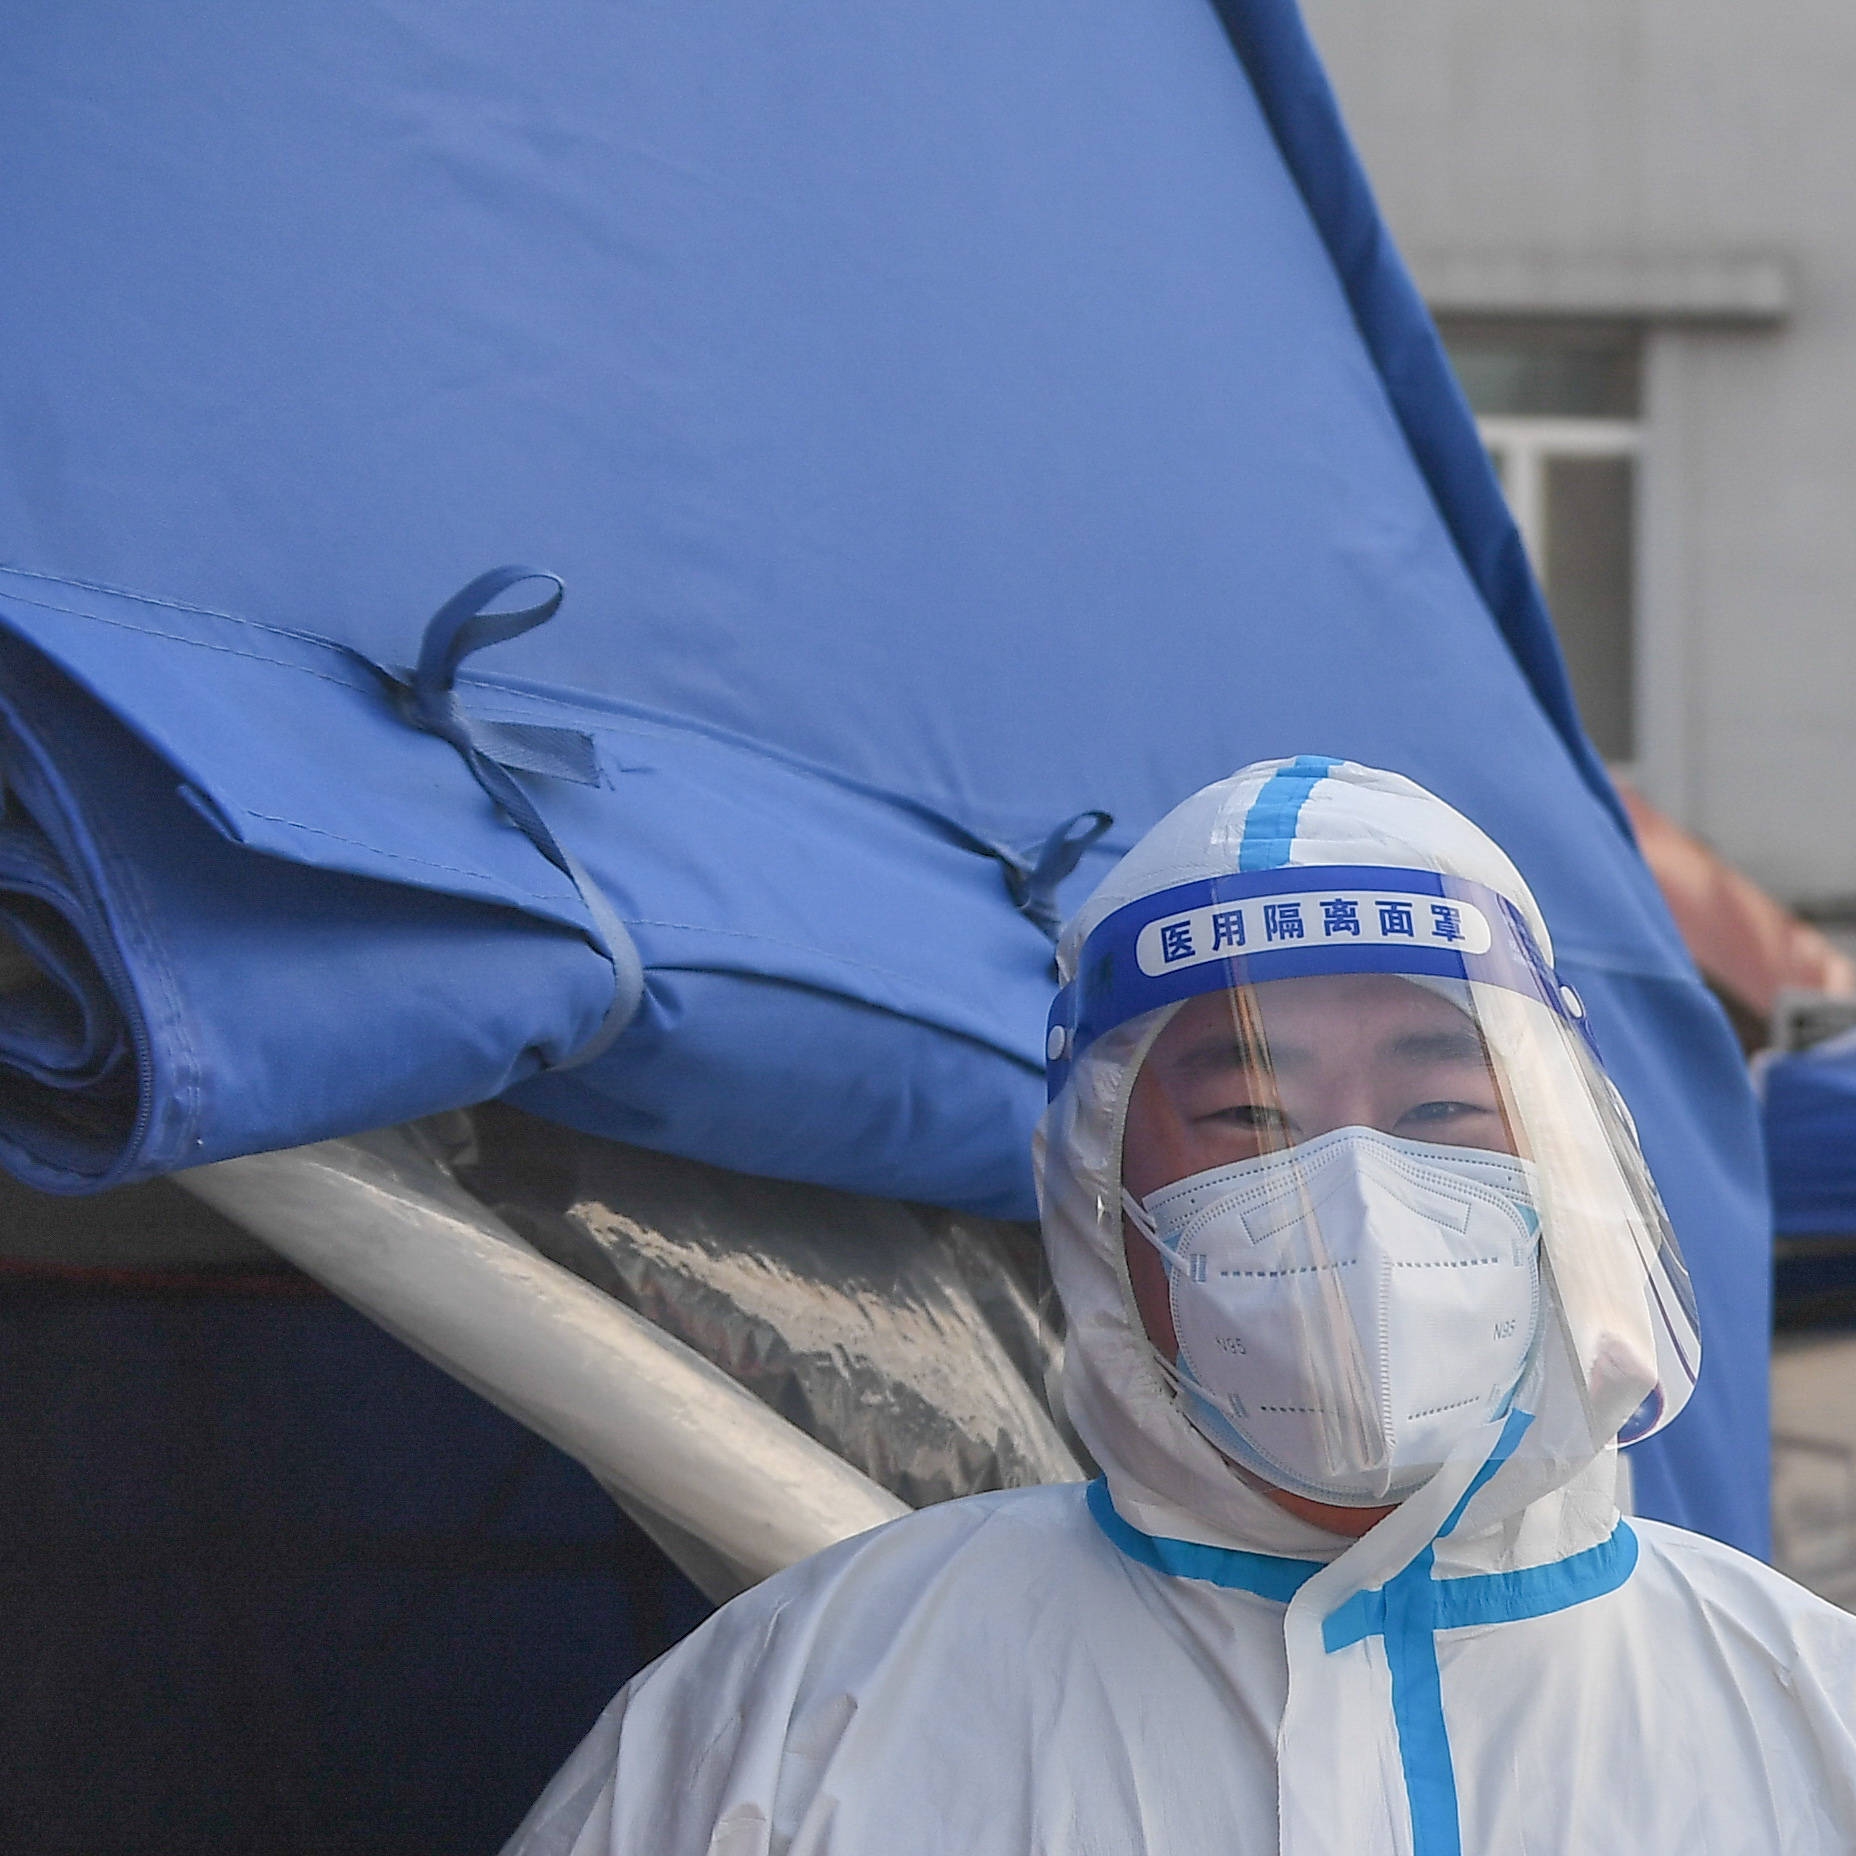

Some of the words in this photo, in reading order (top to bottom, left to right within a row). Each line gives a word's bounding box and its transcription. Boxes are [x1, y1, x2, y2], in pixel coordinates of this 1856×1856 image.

[1160, 898, 1466, 963] 医用隔离面罩
